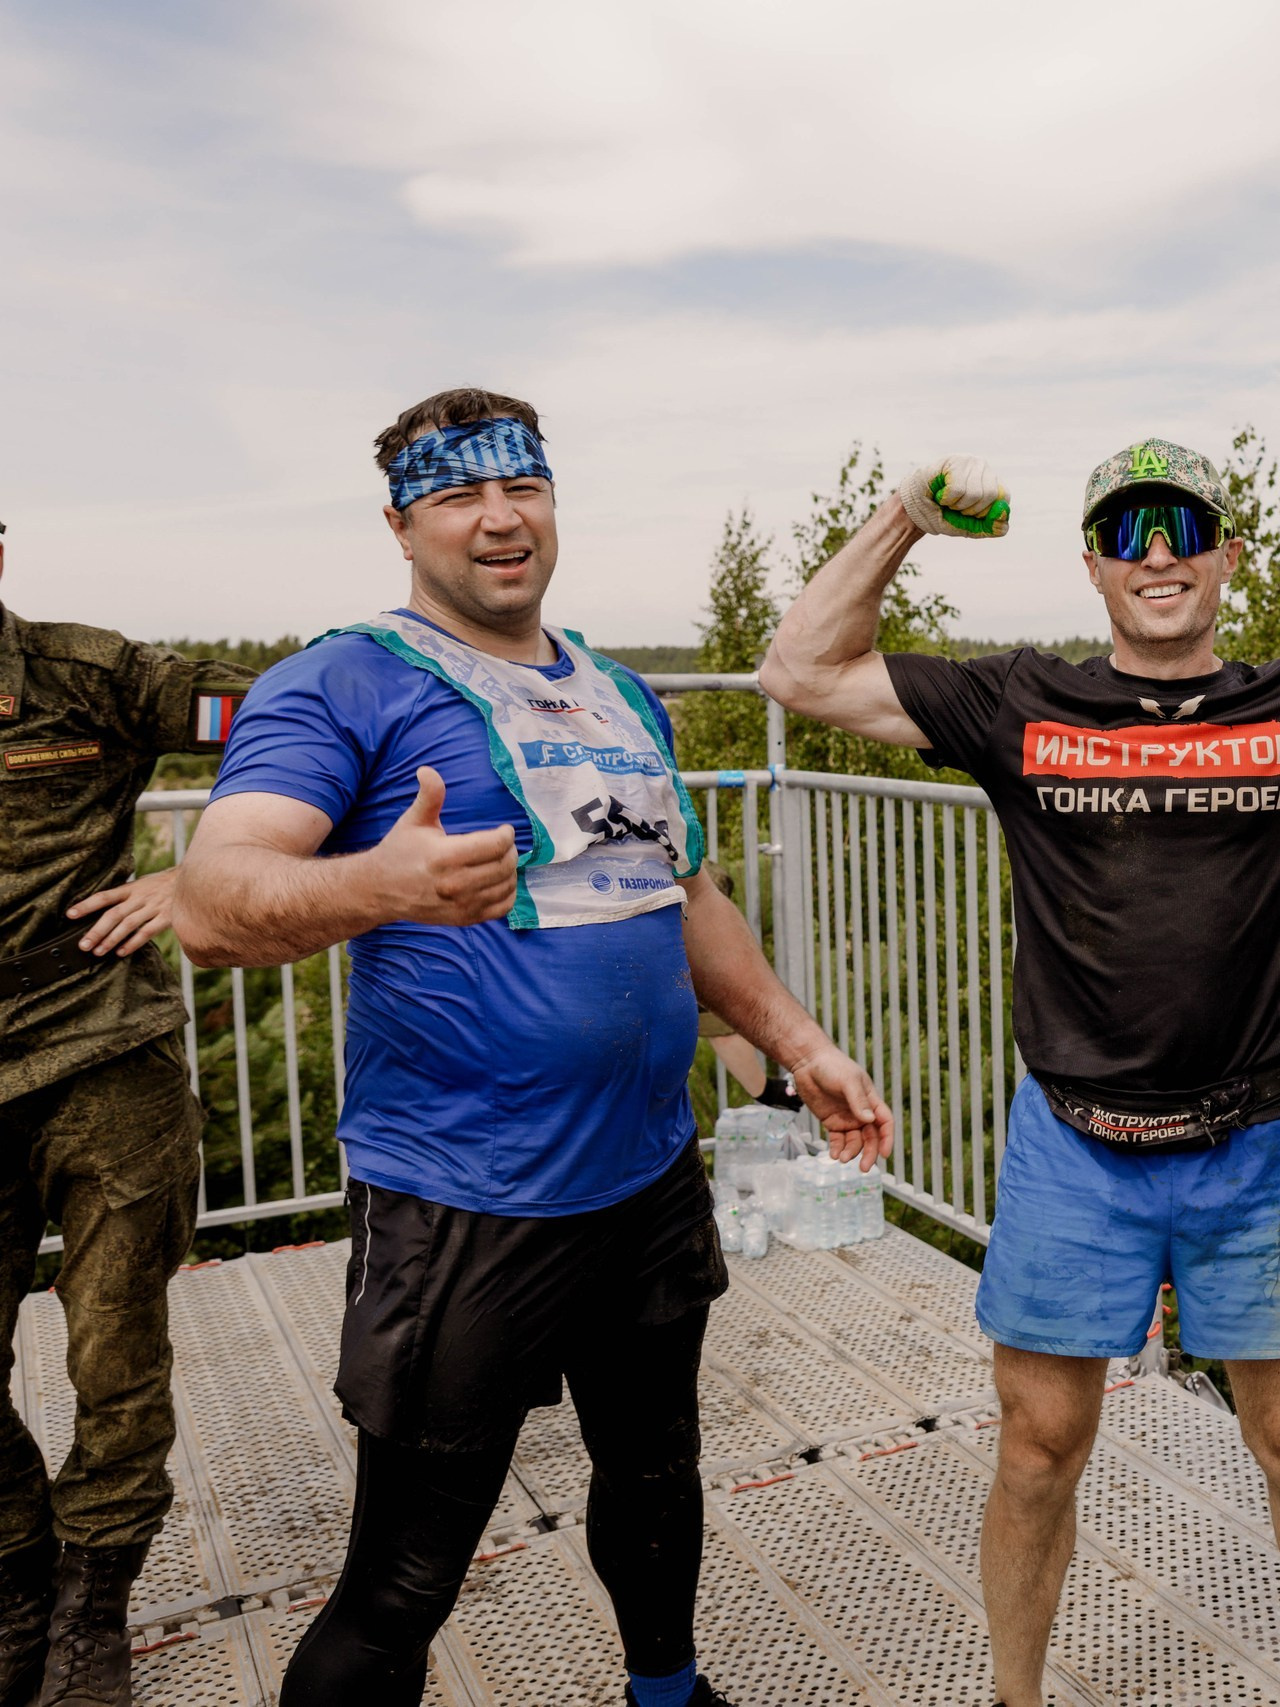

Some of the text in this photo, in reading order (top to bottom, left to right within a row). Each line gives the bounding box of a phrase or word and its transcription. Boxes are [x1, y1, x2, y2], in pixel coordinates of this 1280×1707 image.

[1129, 445, 1169, 478] LA
[1036, 786, 1152, 813] ГОНКА
[1087, 1119, 1185, 1142] ГОНКА ГЕРОЕВ
